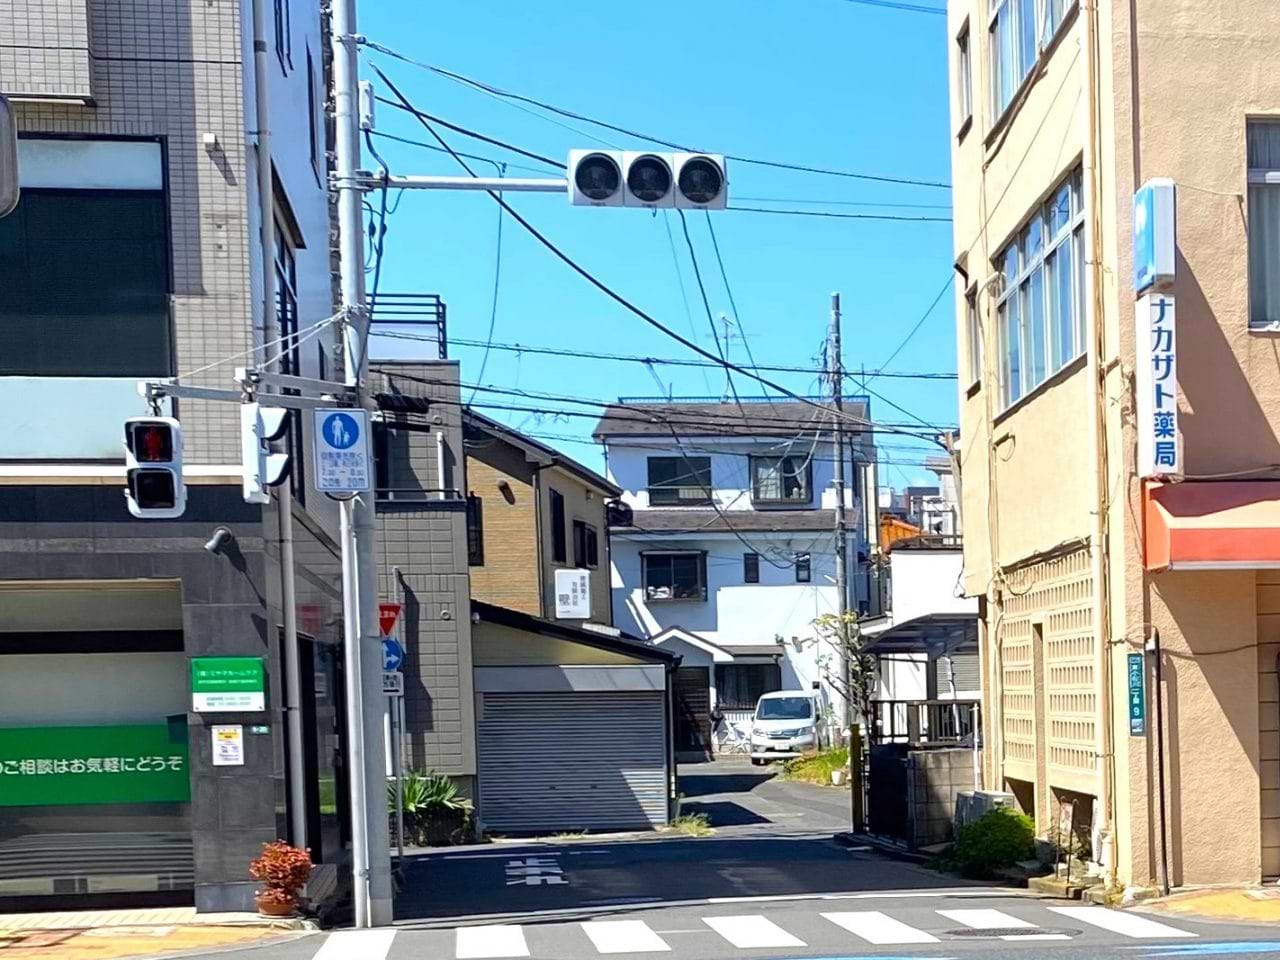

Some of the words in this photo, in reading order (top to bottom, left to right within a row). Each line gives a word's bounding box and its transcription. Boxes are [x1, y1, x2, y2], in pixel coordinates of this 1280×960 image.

[1150, 298, 1175, 468] ナカザト薬局
